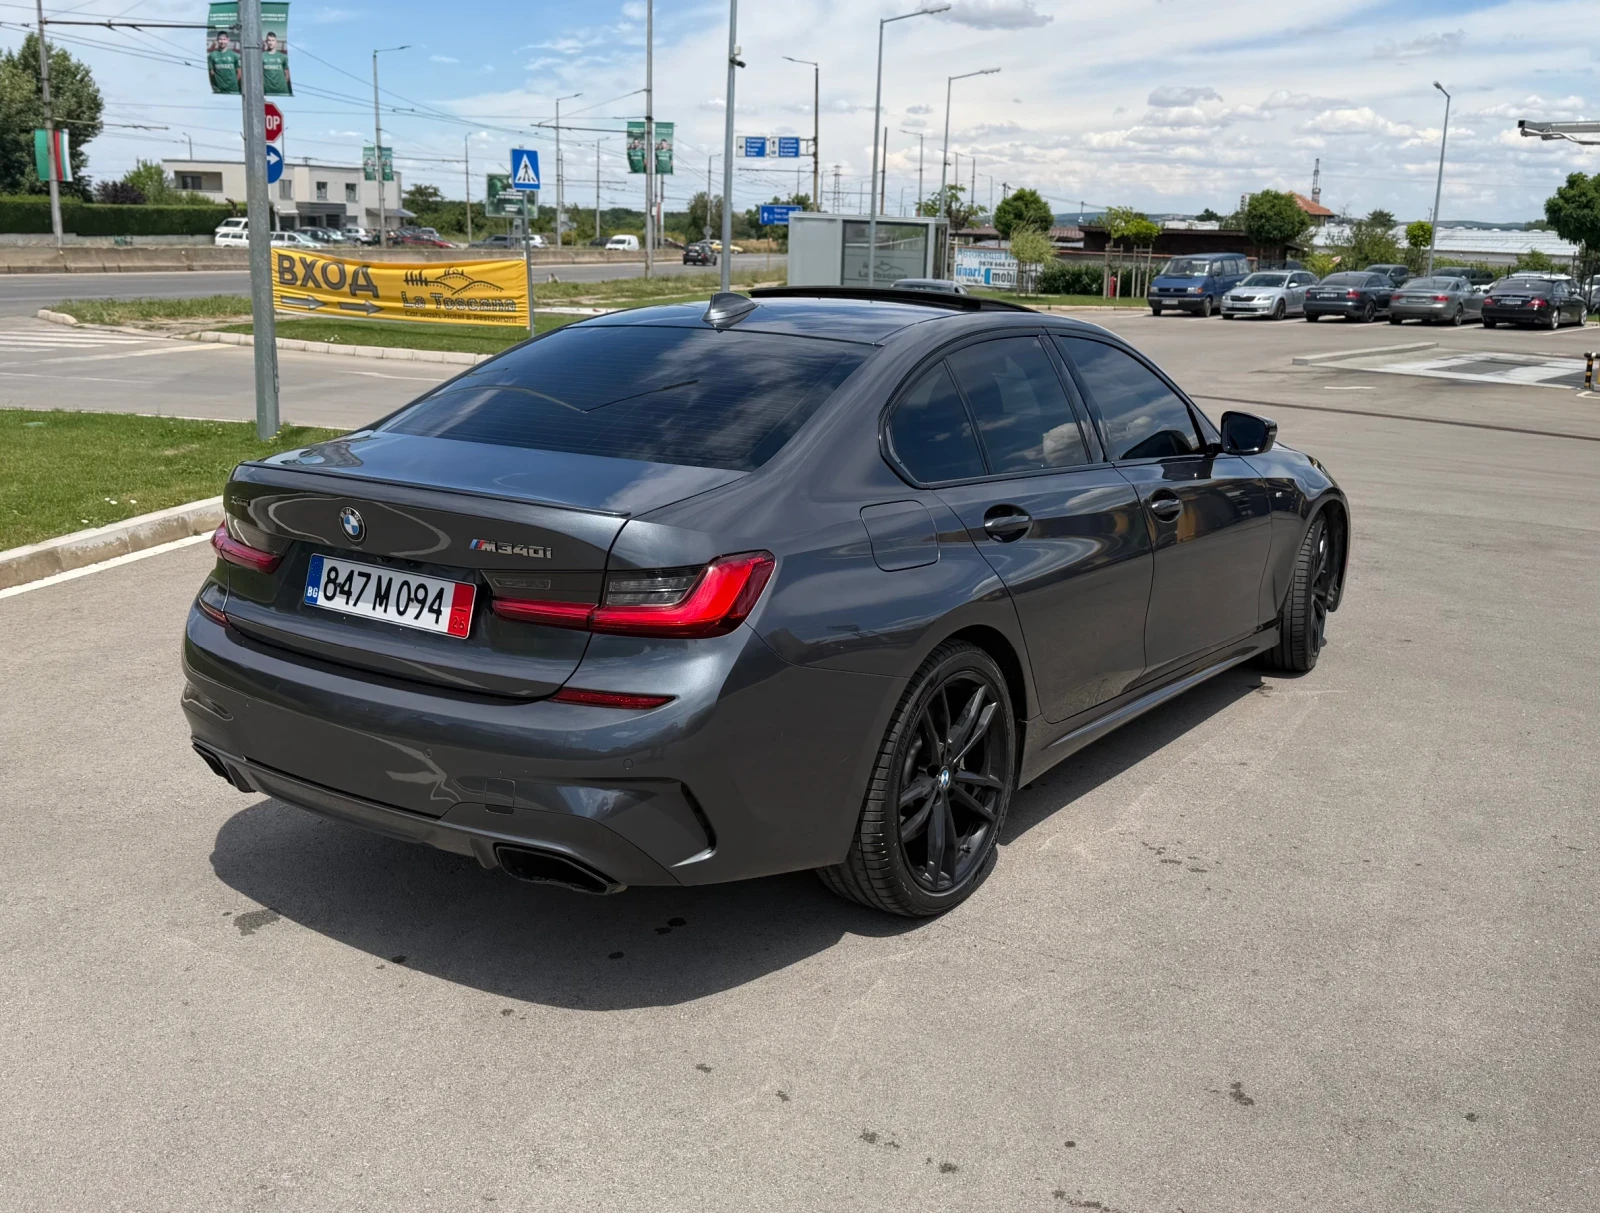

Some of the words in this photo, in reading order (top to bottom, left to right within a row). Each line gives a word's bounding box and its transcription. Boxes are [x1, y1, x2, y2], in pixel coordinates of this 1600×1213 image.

[264, 115, 280, 130] OP
[278, 254, 380, 298] ВХОД
[401, 291, 426, 309] La
[430, 292, 517, 312] Toscana
[474, 314, 518, 323] Restaurant
[480, 540, 552, 559] M340i
[307, 586, 319, 598] BG
[452, 615, 465, 630] 26
